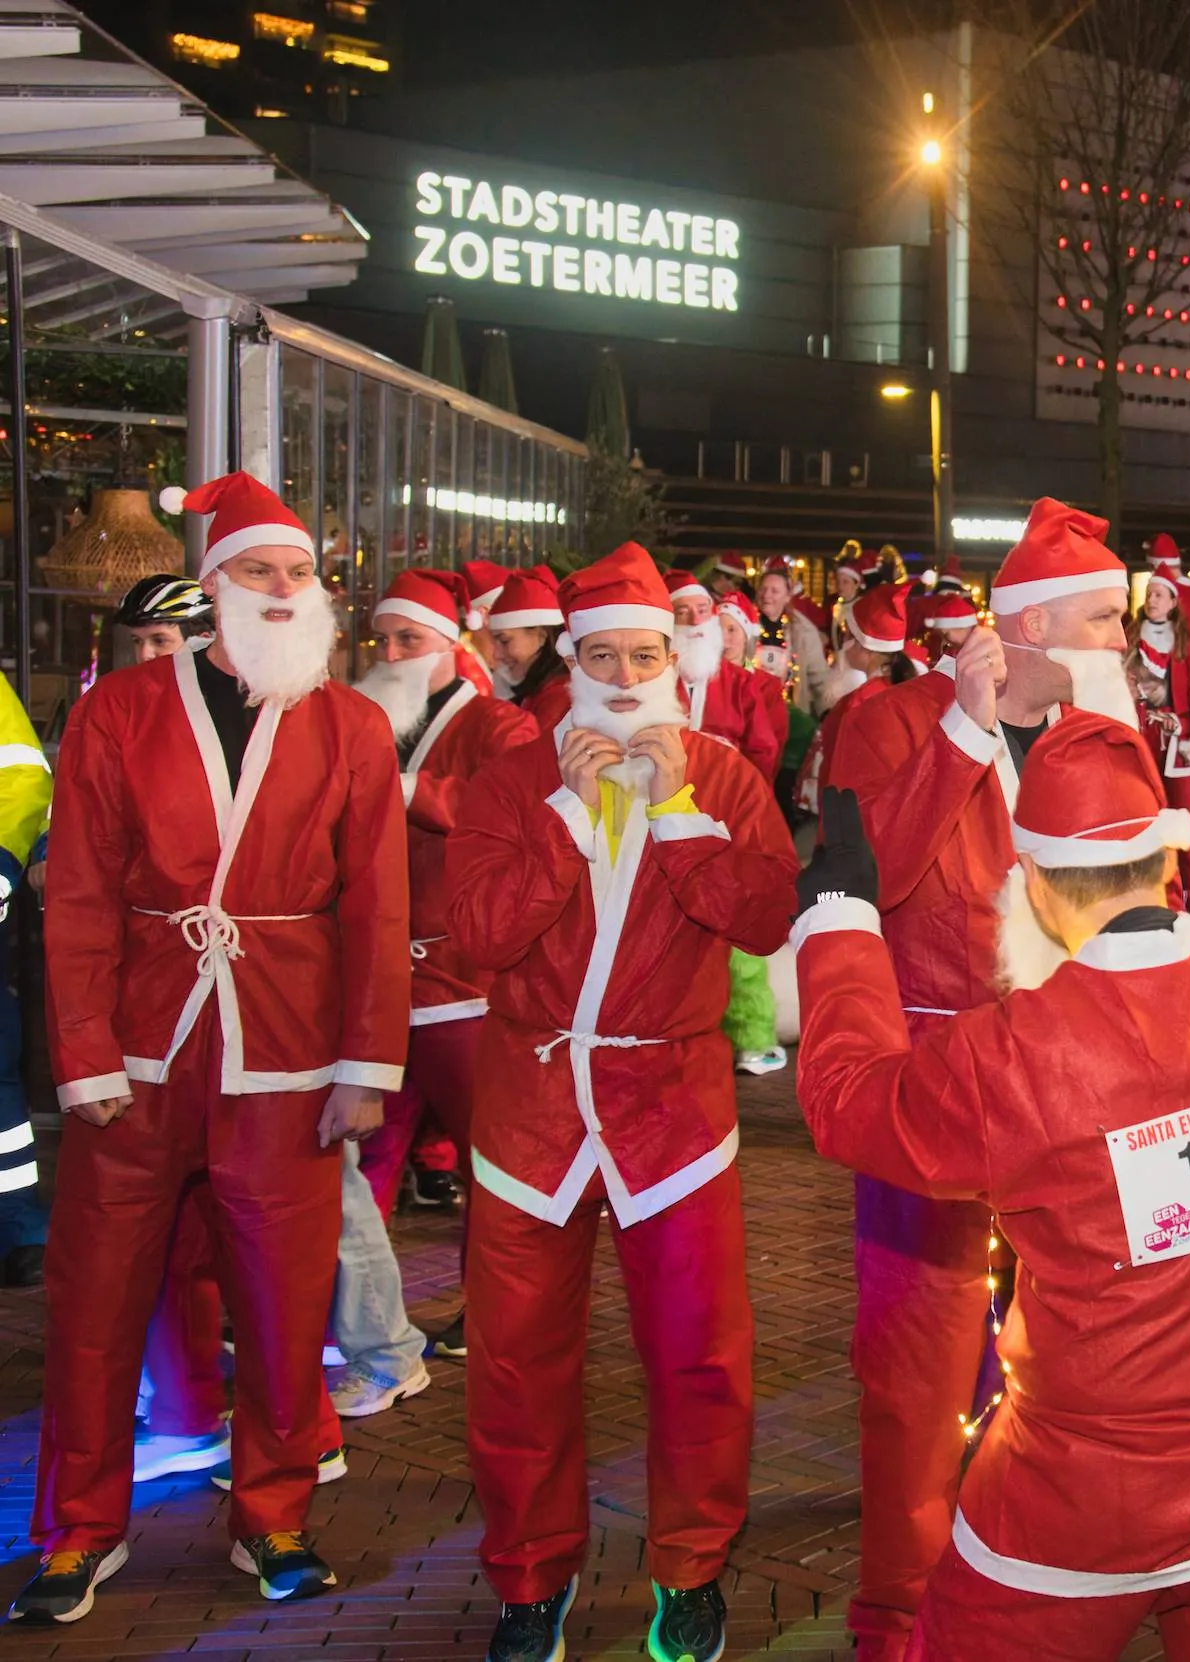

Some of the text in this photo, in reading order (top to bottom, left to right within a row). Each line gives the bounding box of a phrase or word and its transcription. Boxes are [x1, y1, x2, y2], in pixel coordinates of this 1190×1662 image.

[415, 171, 740, 260] STADSTHEATER
[414, 226, 739, 312] ZOETERMEER
[816, 890, 846, 905] HEAT
[1126, 1124, 1176, 1152] SANTA
[1153, 1203, 1180, 1224] EEN
